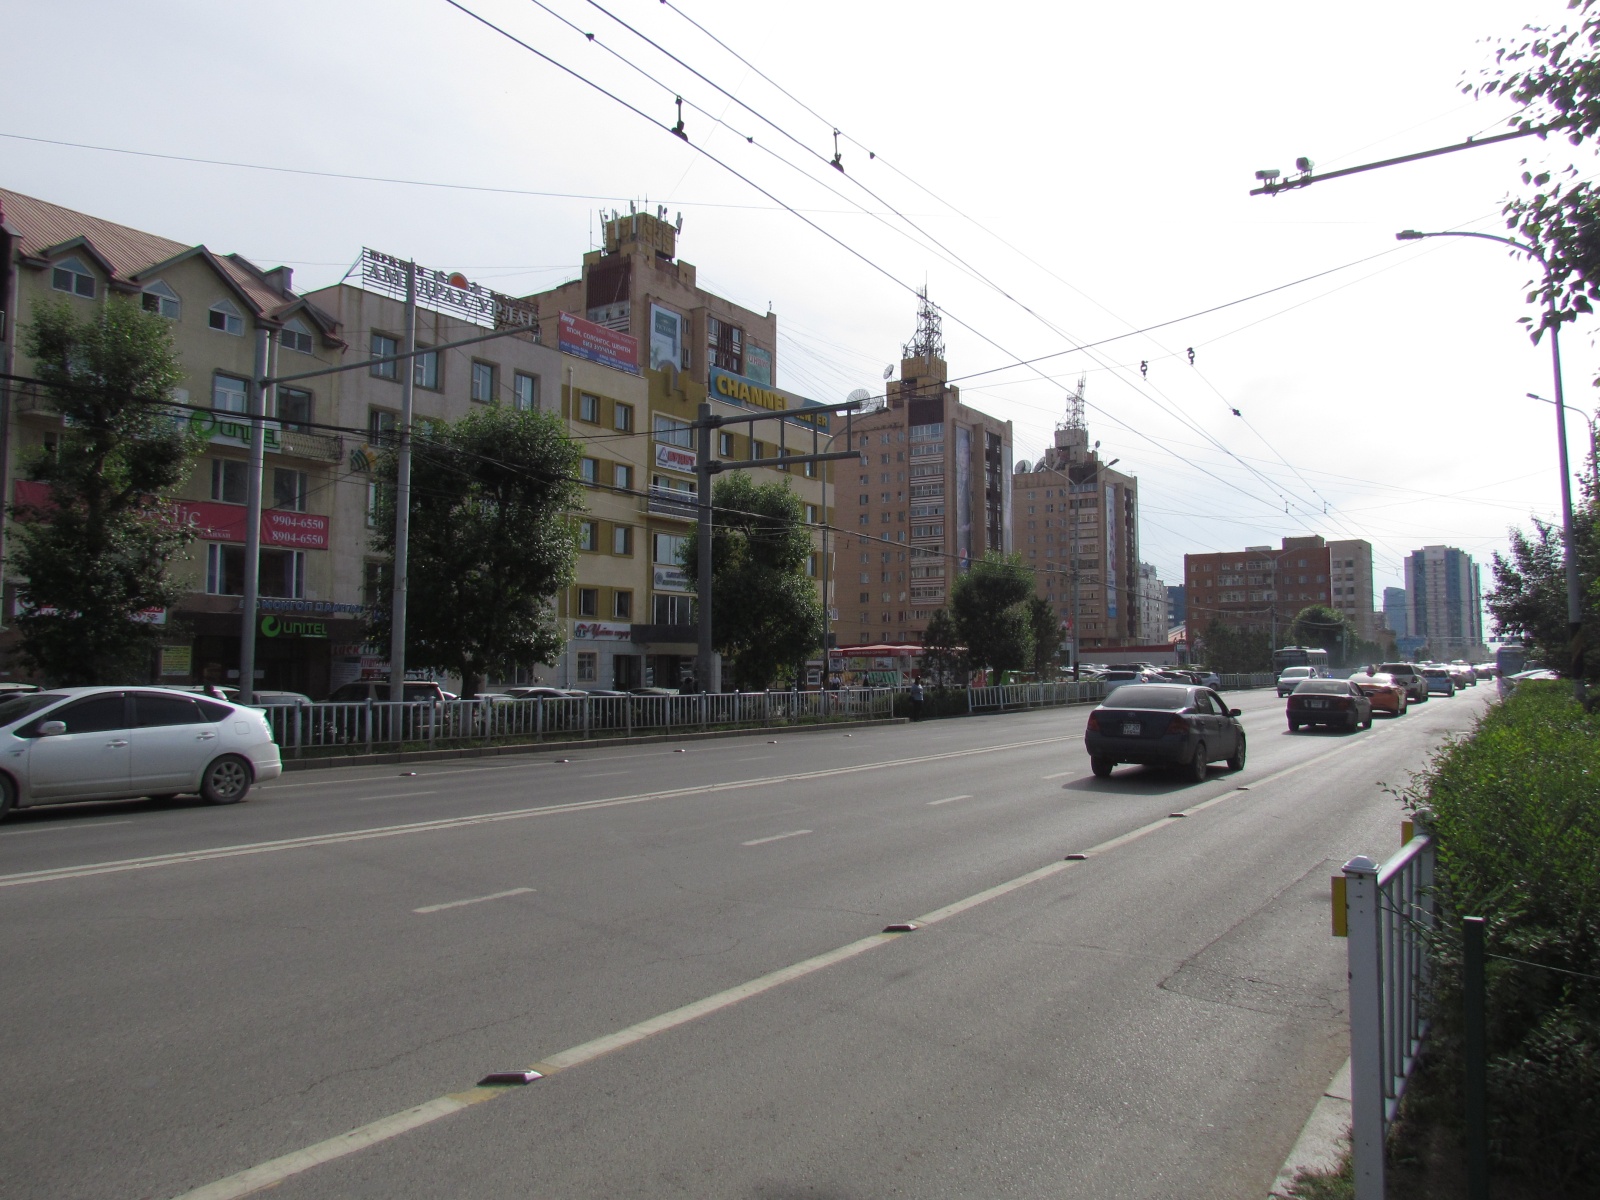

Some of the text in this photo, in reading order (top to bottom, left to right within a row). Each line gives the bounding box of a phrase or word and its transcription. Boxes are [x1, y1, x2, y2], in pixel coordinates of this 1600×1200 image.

[368, 263, 471, 307] АМДРАХ
[272, 514, 324, 530] 9904-6550
[272, 530, 324, 545] 8904-6550
[283, 621, 328, 634] UNITEL
